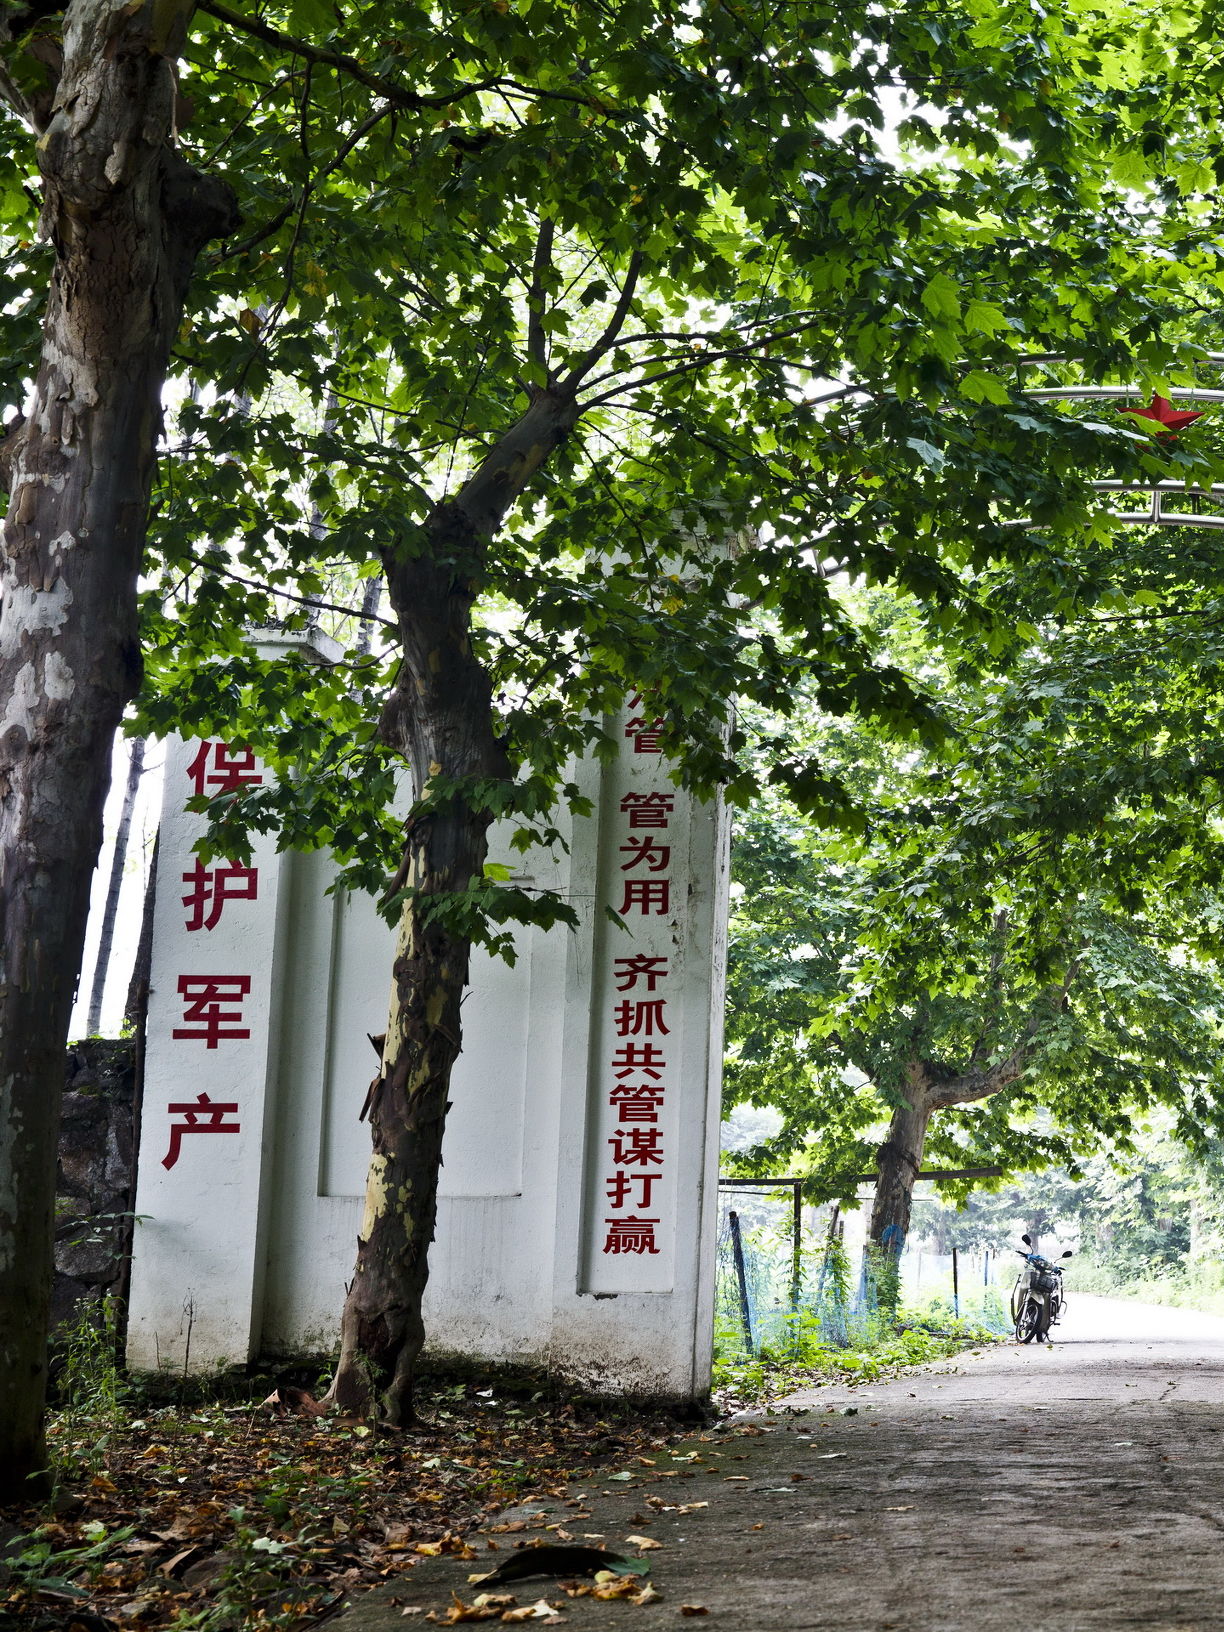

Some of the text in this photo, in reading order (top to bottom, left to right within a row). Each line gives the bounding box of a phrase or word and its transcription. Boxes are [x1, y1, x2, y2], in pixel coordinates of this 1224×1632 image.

[160, 740, 263, 1172] 保护军产
[617, 791, 676, 916] 管为用
[602, 953, 671, 1255] 齐抓共管谋打赢
